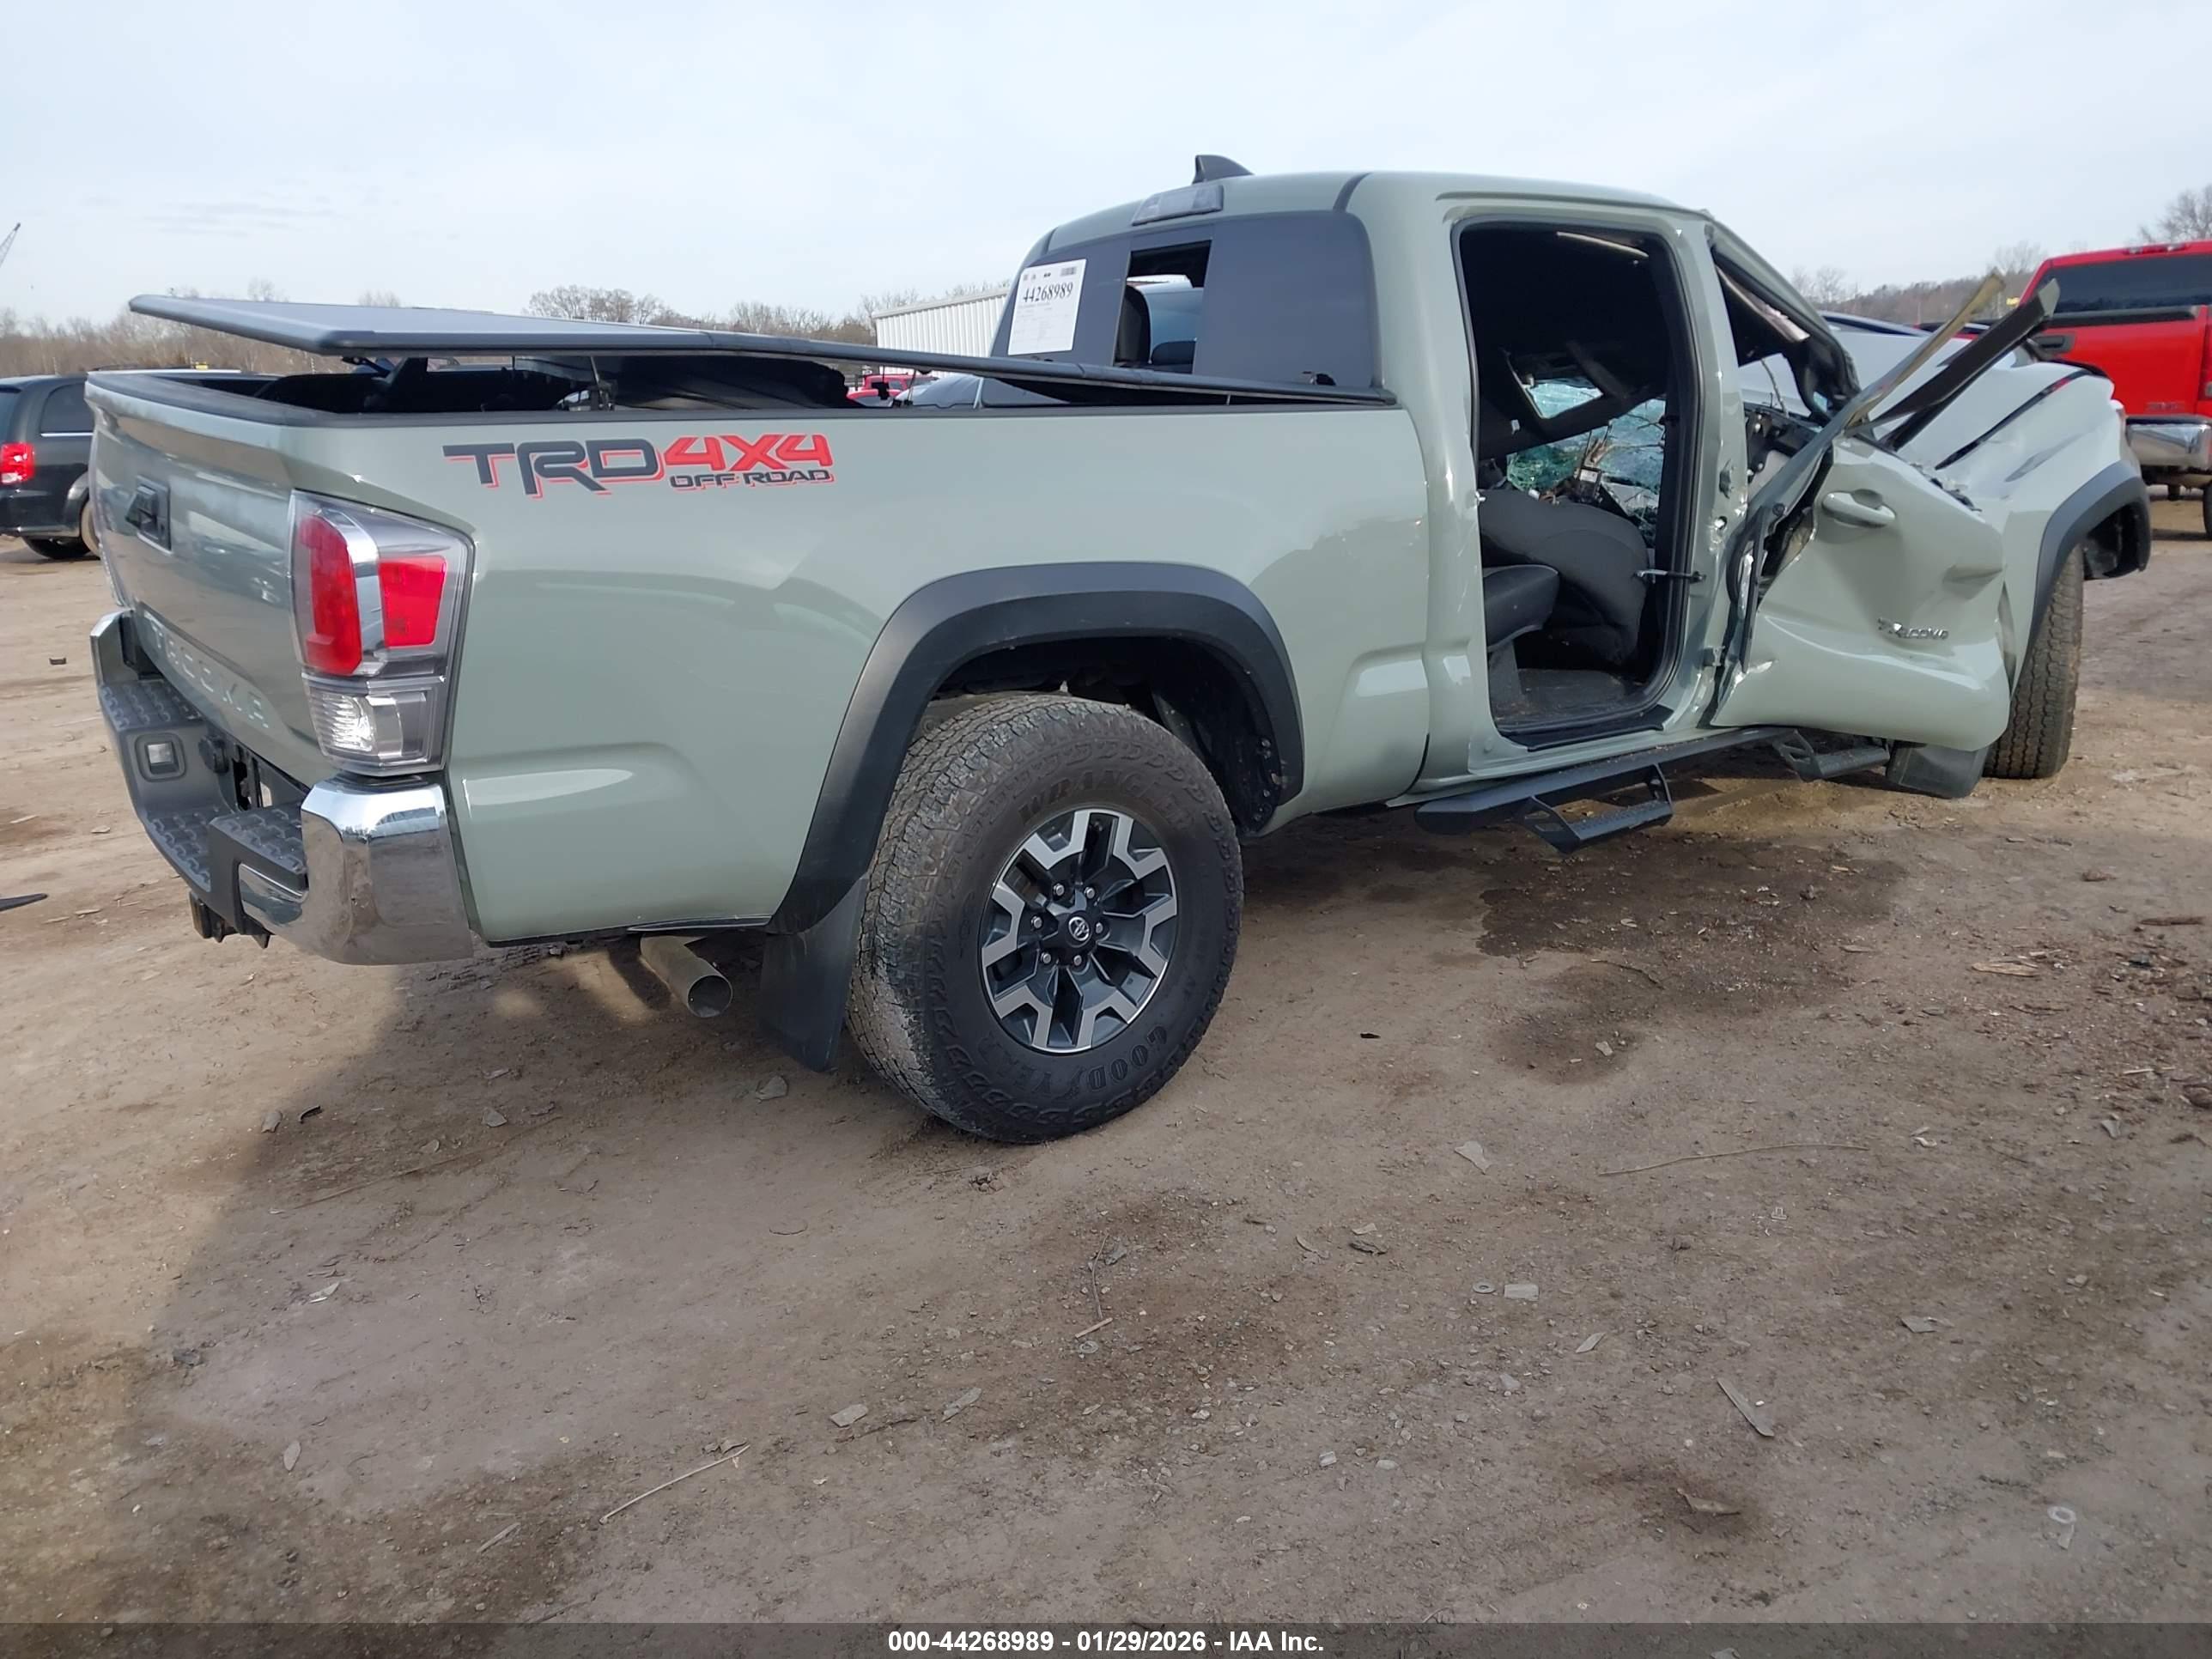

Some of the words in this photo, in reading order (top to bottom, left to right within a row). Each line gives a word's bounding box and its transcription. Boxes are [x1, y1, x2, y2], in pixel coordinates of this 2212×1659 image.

[1023, 281, 1074, 303] 44268989
[442, 438, 665, 497] TRD
[670, 472, 739, 490] OFF
[744, 469, 836, 487] ROAD
